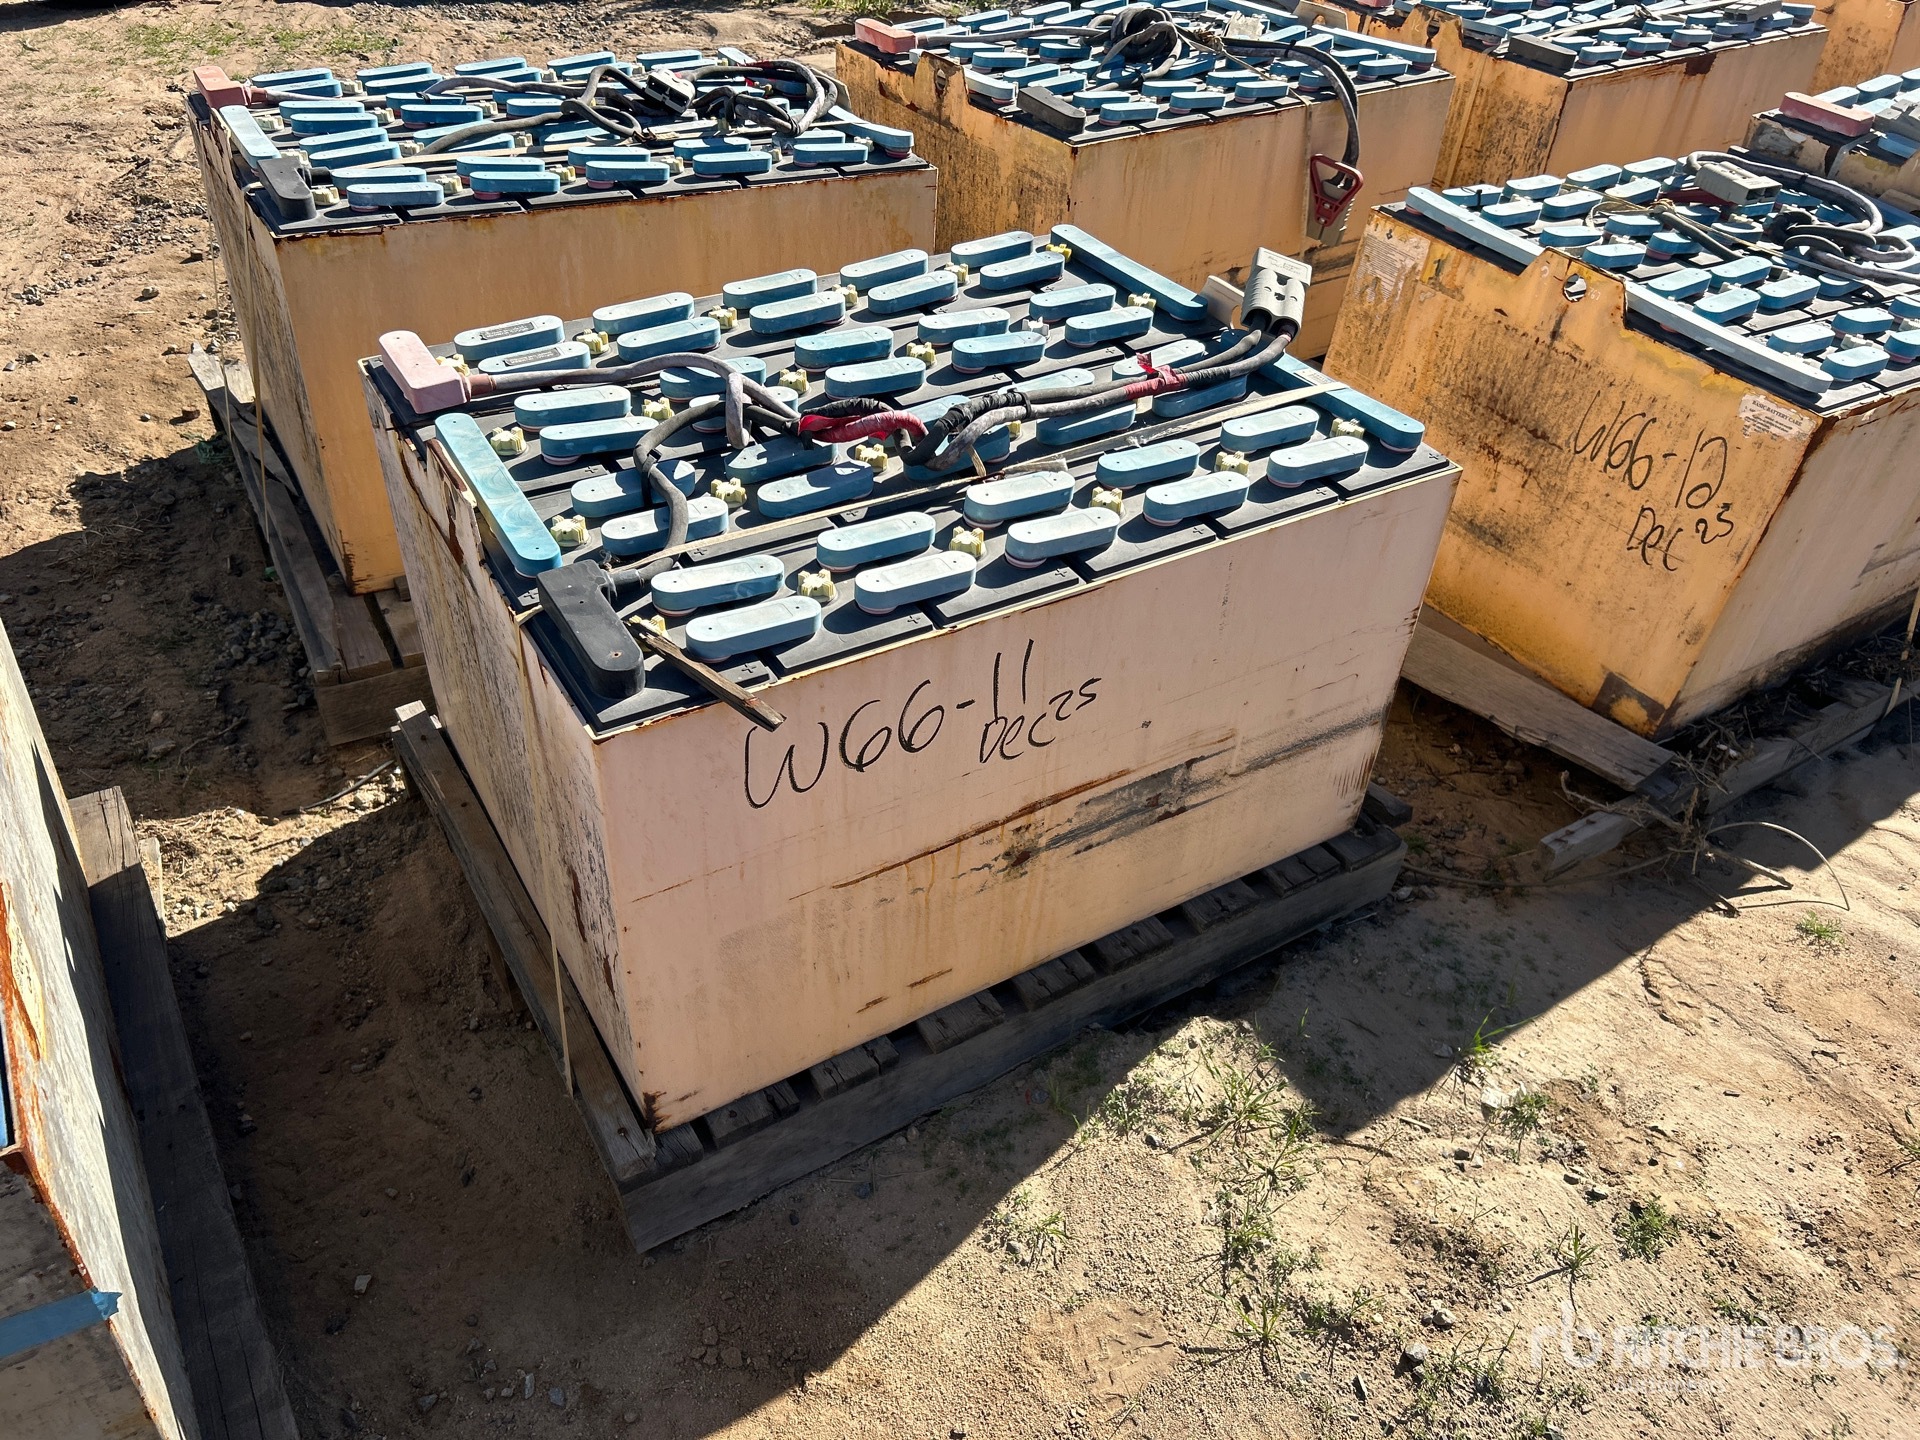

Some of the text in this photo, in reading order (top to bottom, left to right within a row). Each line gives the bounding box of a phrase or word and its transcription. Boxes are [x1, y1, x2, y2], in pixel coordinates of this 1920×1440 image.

[1573, 390, 1728, 509] W66-12
[1751, 400, 1803, 427] BASIC BATTERY CARE
[744, 638, 1034, 809] W66-11
